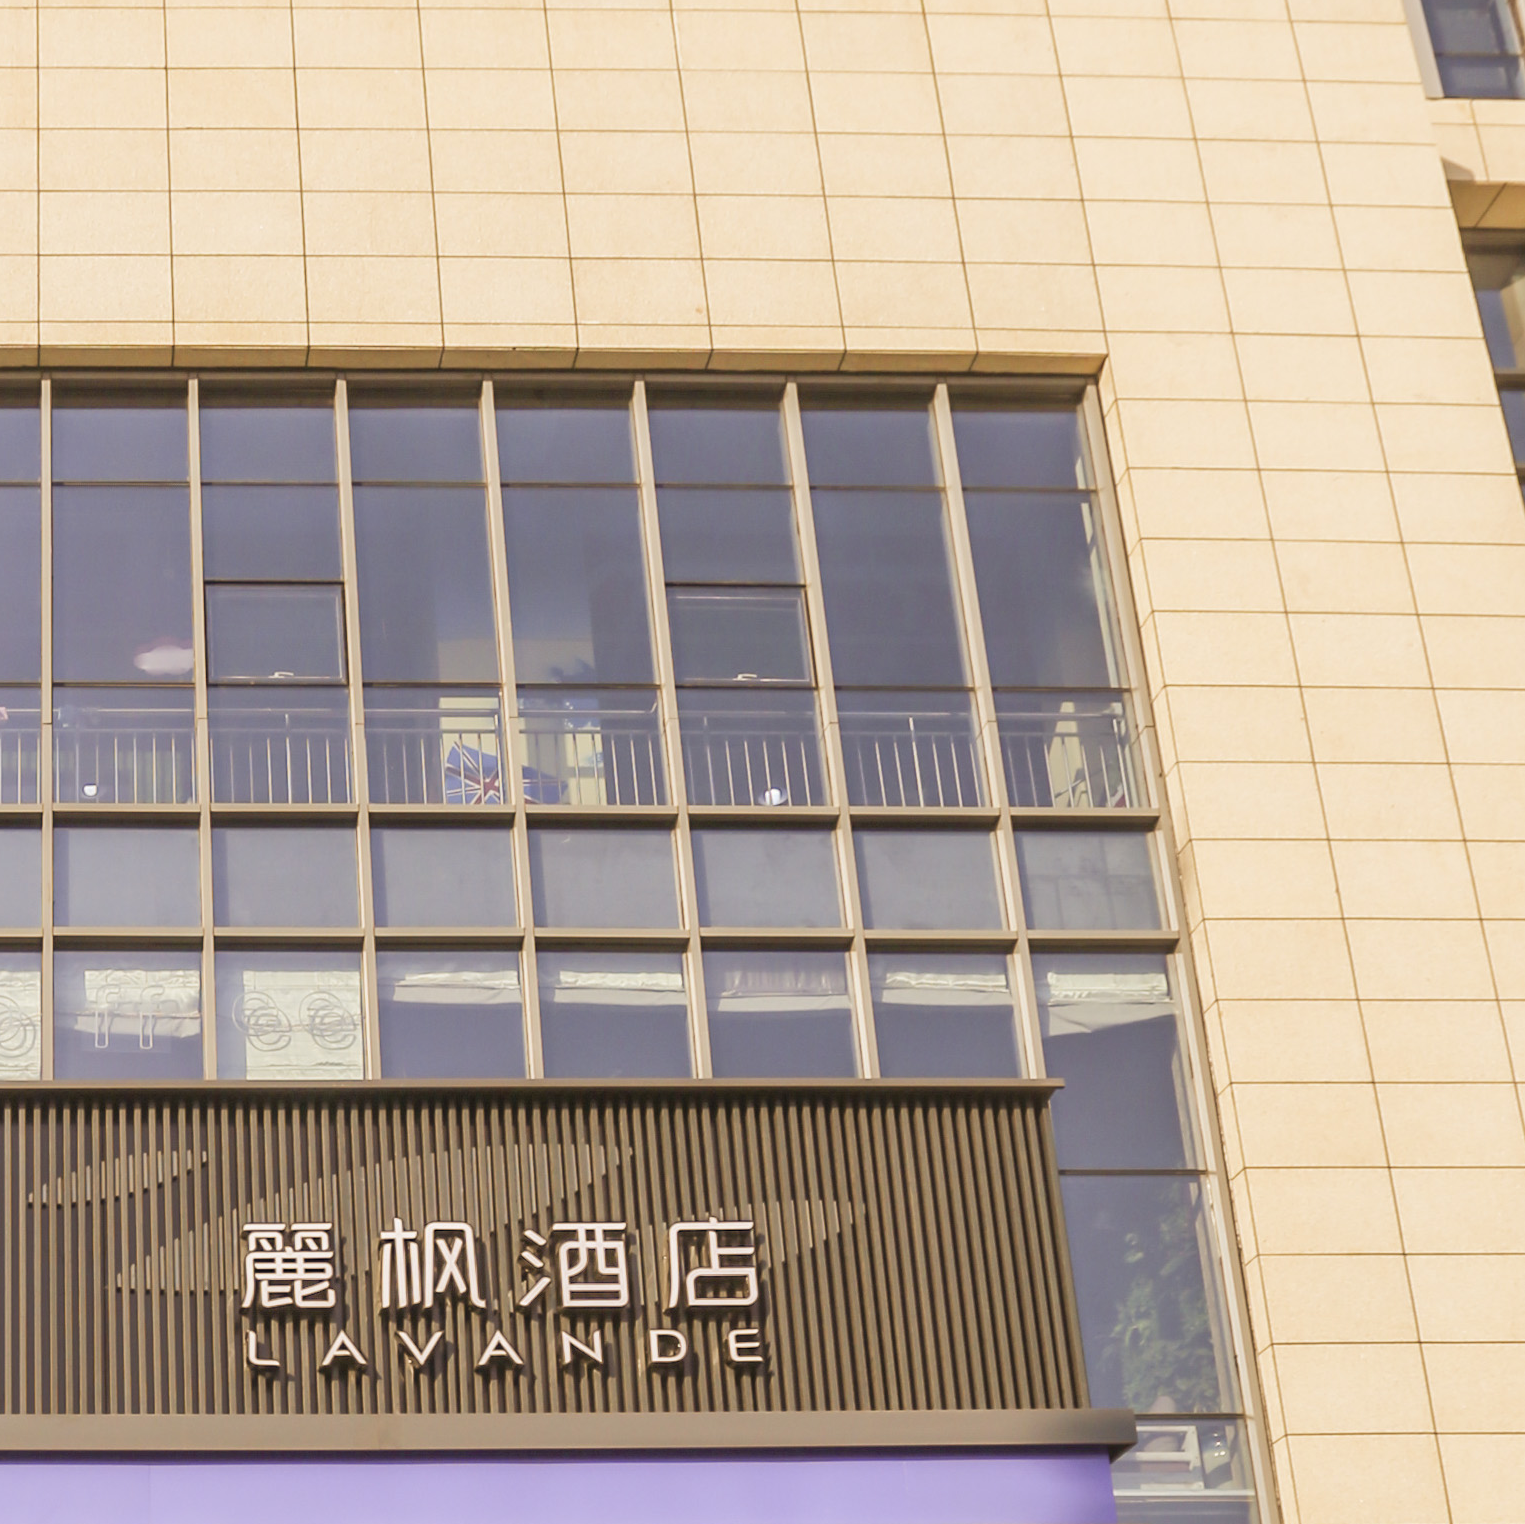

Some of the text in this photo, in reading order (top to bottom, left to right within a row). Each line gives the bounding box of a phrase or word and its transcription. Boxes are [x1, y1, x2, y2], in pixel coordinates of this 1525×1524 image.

[241, 1217, 760, 1310] 麗枫酒店
[245, 1327, 765, 1367] LAVANDE
